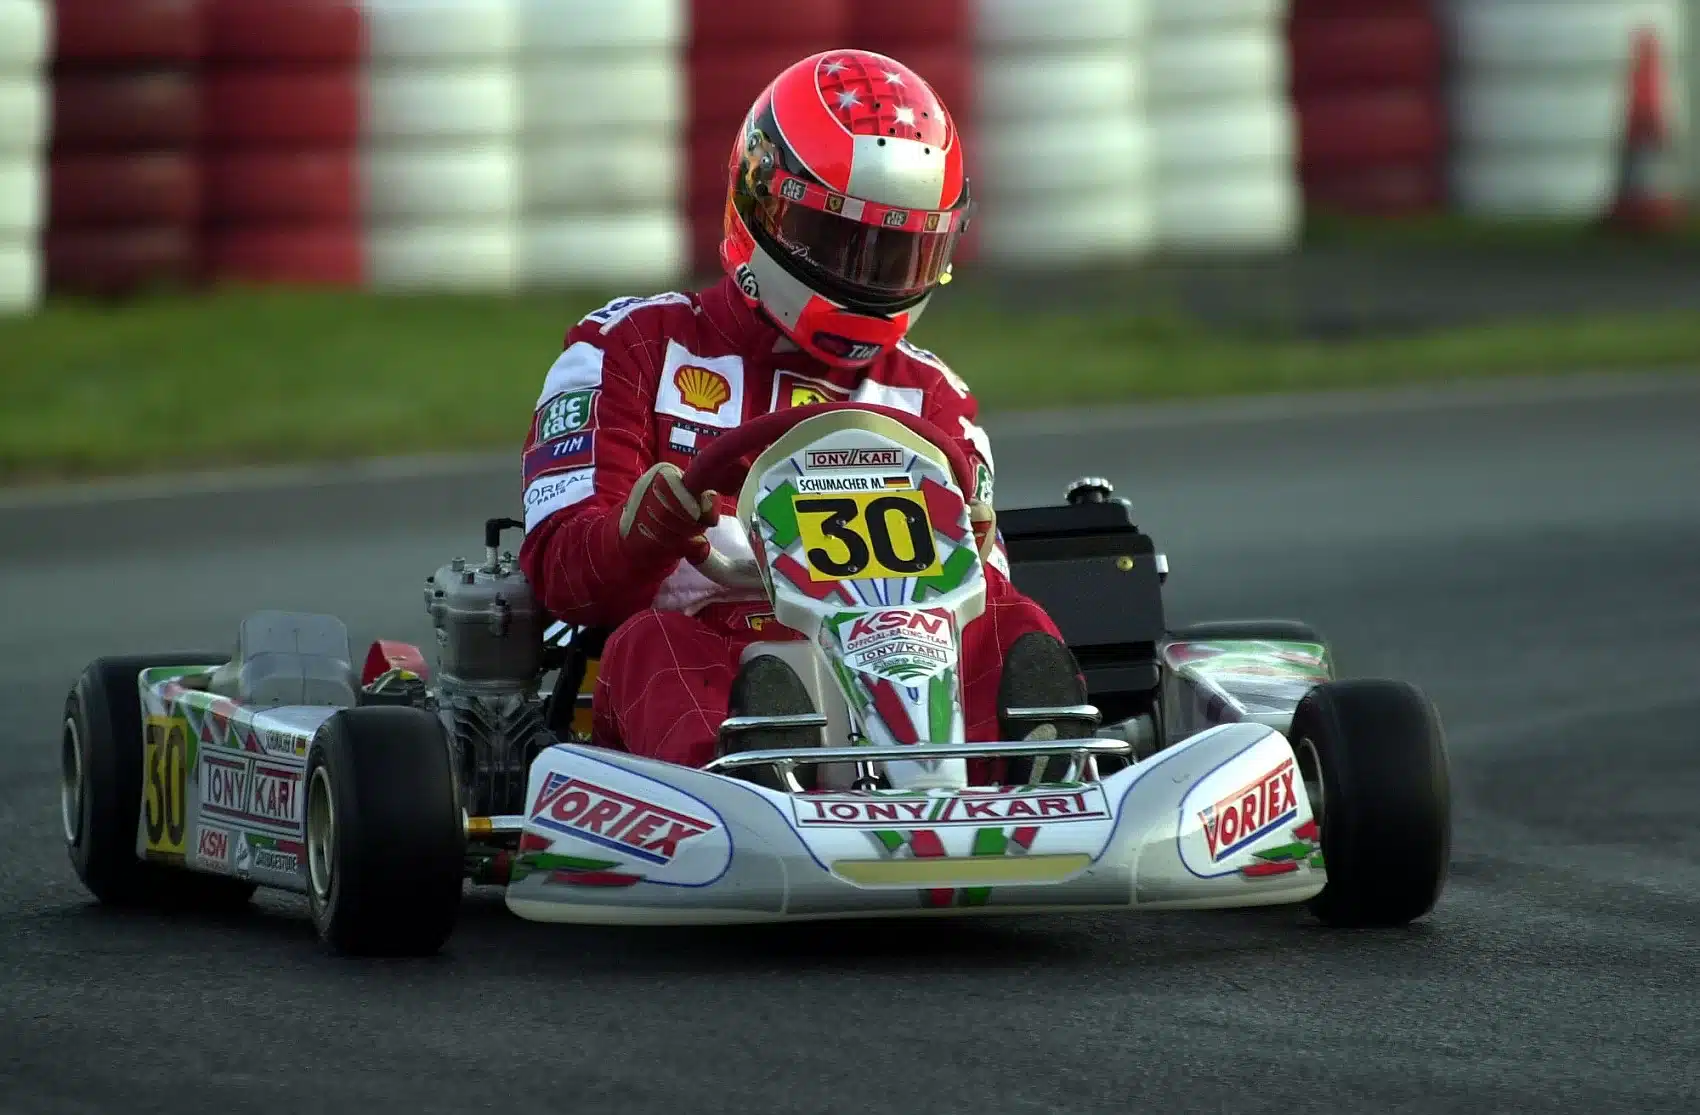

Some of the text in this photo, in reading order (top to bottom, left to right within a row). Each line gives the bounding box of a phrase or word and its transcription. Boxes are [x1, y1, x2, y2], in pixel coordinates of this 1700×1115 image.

[550, 396, 581, 420] tic
[543, 413, 581, 440] tac
[553, 436, 584, 456] TIM
[809, 449, 898, 466] TONY KART
[799, 477, 885, 492] SCHUMACHER M.
[795, 496, 936, 577] 30
[848, 610, 943, 642] KSN
[145, 723, 186, 847] 30
[207, 762, 297, 820] TONY KART
[530, 771, 716, 858] VORTEX
[809, 793, 1088, 821] TONY KART
[1198, 758, 1298, 861] VORTEX
